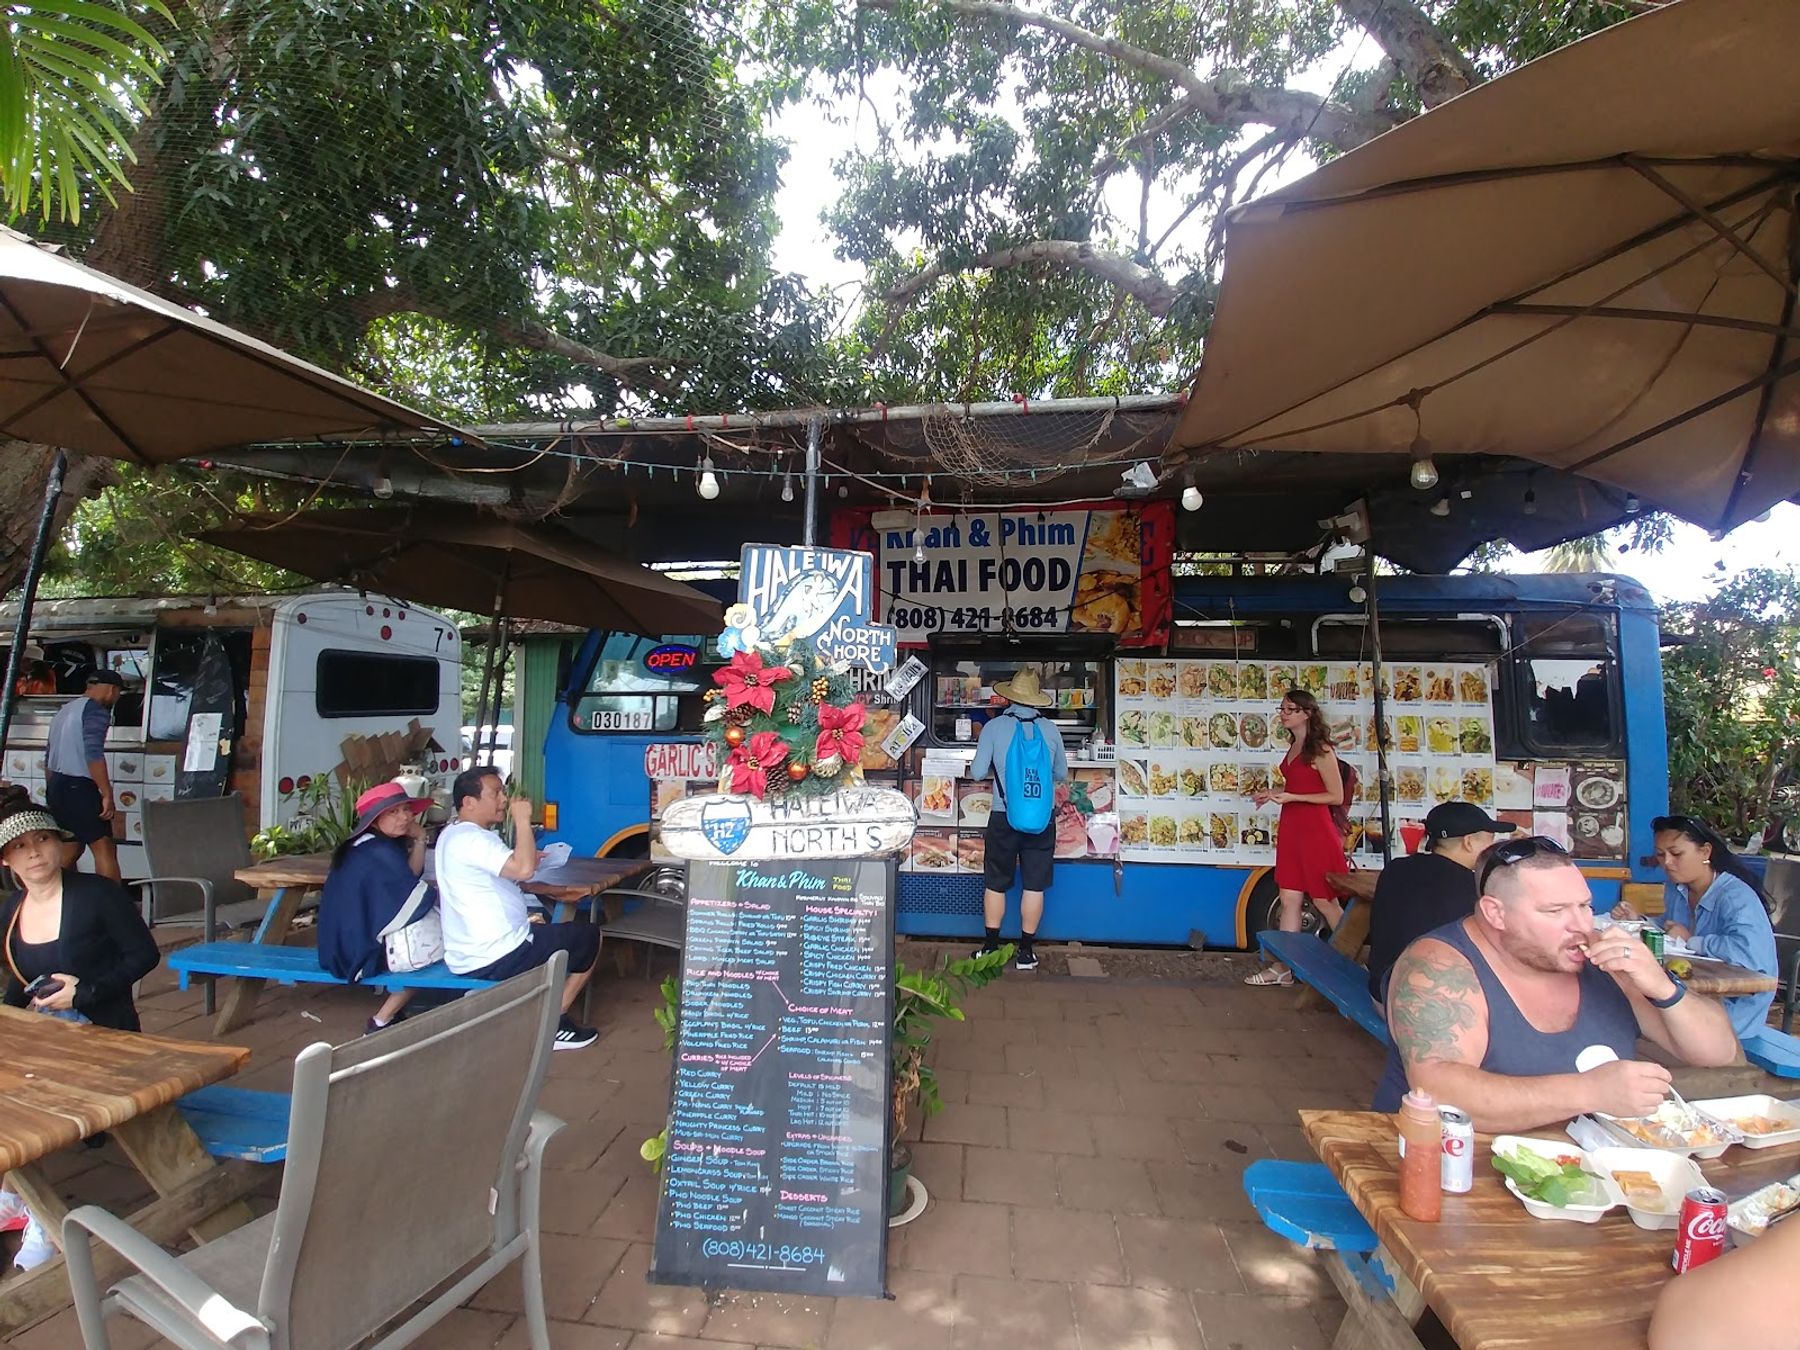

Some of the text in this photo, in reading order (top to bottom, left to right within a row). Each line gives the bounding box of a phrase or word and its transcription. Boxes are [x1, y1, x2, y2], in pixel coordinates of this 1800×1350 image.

[968, 518, 991, 548] &
[1001, 517, 1076, 546] Phim
[886, 556, 1071, 593] THAI FOOD
[887, 606, 945, 634] (808)
[830, 615, 891, 646] NORTH
[434, 627, 444, 653] 7
[816, 631, 888, 675] SHORE
[647, 652, 696, 667] OPEN
[594, 712, 651, 729] 030187
[645, 744, 701, 778] GARLIC
[1024, 784, 1040, 797] 30
[772, 826, 857, 854] NORTH
[690, 898, 771, 910] APPETIZERS SALAD
[806, 905, 833, 913] HOUSE
[831, 934, 856, 942] STEAK
[803, 942, 859, 952] GARLIC CHICKEN
[804, 951, 855, 960] SPICY CHICKEN
[804, 960, 871, 972] CRISPY FRIED CHICKEN
[687, 968, 706, 976] RICE
[724, 970, 754, 979] NOODLES
[804, 969, 877, 980] CRISPY CHICKEN CURRY
[804, 978, 866, 989] CRISPY FISH CURRY
[788, 1004, 817, 1013] CHOICE
[830, 1007, 853, 1015] MEAT
[681, 1053, 714, 1062] CURRIES
[680, 1068, 722, 1078] RED CURRY
[680, 1080, 734, 1091] YELLOW CURRY
[679, 1090, 731, 1100] GREEN CURRY
[713, 1102, 732, 1110] CURRY
[677, 1110, 712, 1118] PINEAPPLE
[675, 1120, 766, 1133] NAUGHTY PRINCESS CURRY
[721, 1133, 744, 1142] CURRY
[673, 1140, 766, 1156] SOUPS NOODLE SOUP
[671, 1154, 729, 1165] GINGER SOUP
[671, 1165, 743, 1178] LEMONGRASS SOUP
[670, 1178, 726, 1190] OXTAIL SOUP
[669, 1189, 742, 1203] PHO NOODLE SOUP
[780, 1190, 828, 1202] DESSERTS
[693, 1202, 713, 1210] BEEF
[693, 1212, 727, 1221] CHICKEN
[694, 1221, 728, 1232] SEAFOOD
